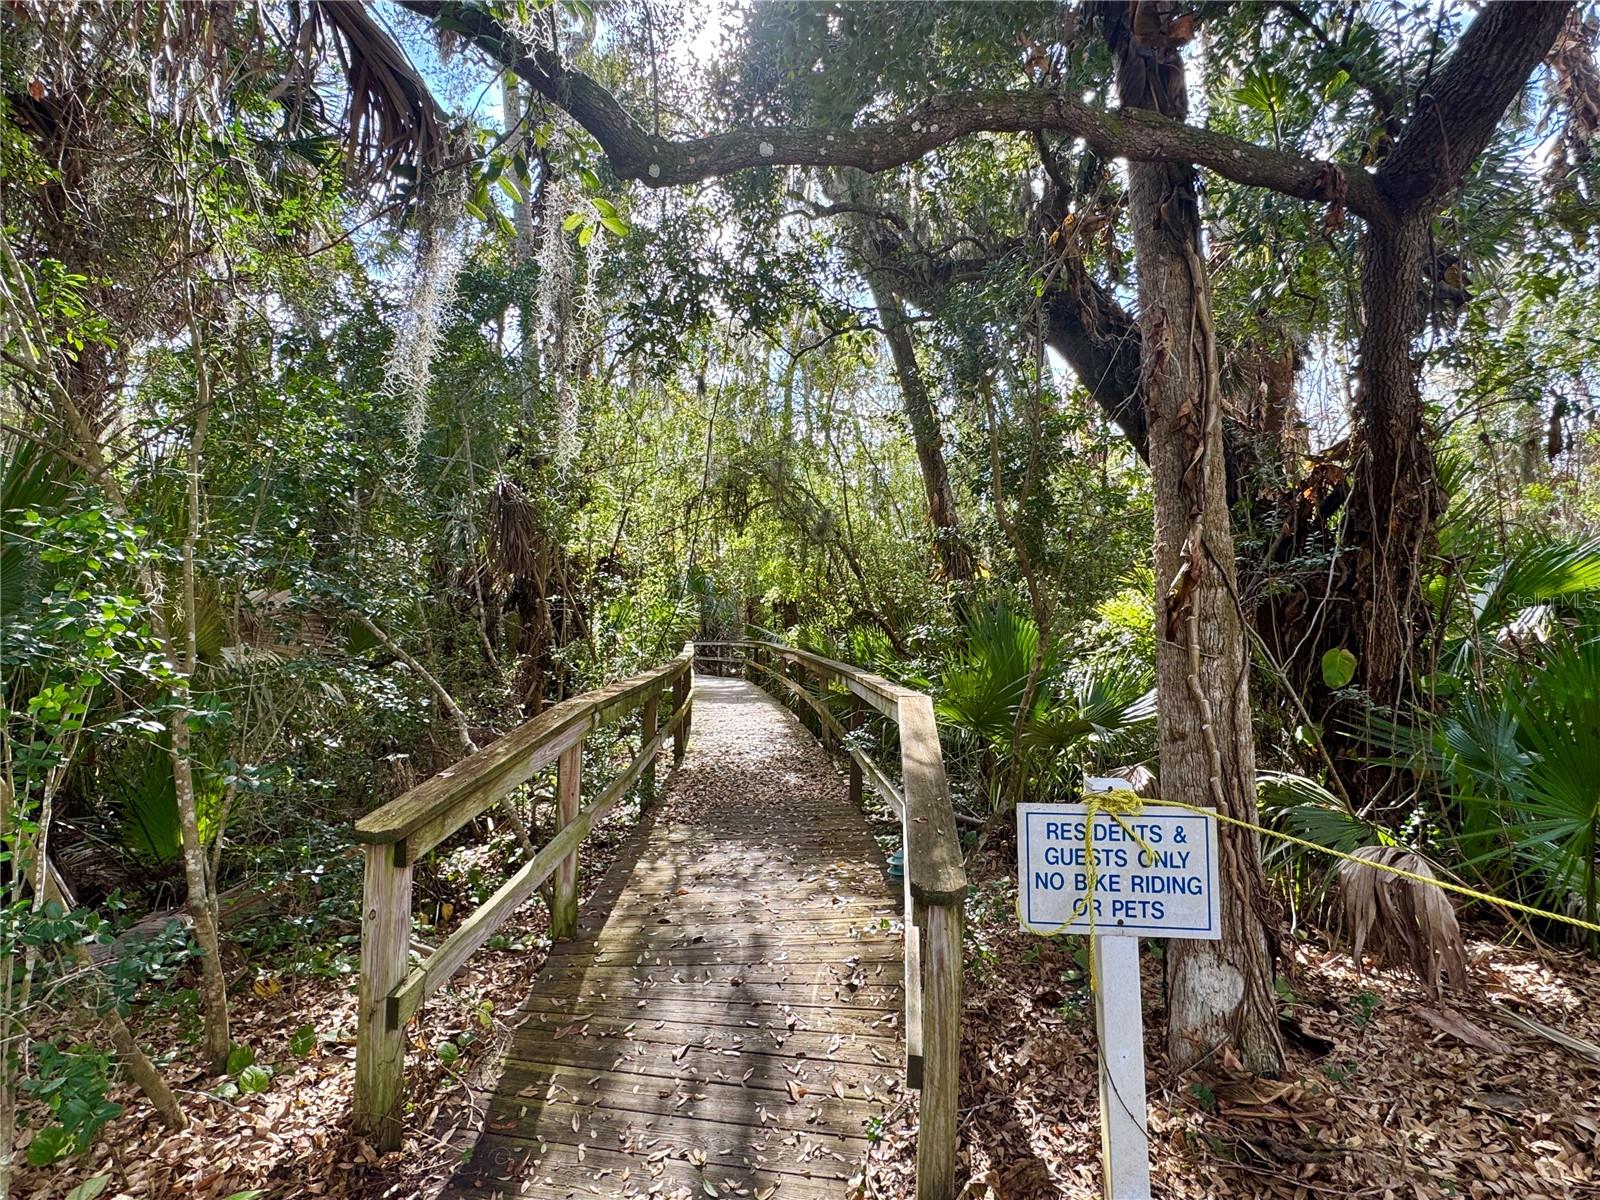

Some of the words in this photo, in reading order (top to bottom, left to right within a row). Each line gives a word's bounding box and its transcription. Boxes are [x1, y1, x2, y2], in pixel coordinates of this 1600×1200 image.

[1046, 822, 1163, 844] RESDENTS
[1173, 825, 1187, 844] &
[1044, 846, 1128, 868] GUESTS
[1137, 849, 1191, 869] ONLY
[1035, 871, 1065, 891] NO
[1074, 873, 1121, 892] BKE
[1131, 875, 1202, 895] RIDING
[1072, 898, 1102, 917] OR
[1112, 899, 1165, 920] PETS
